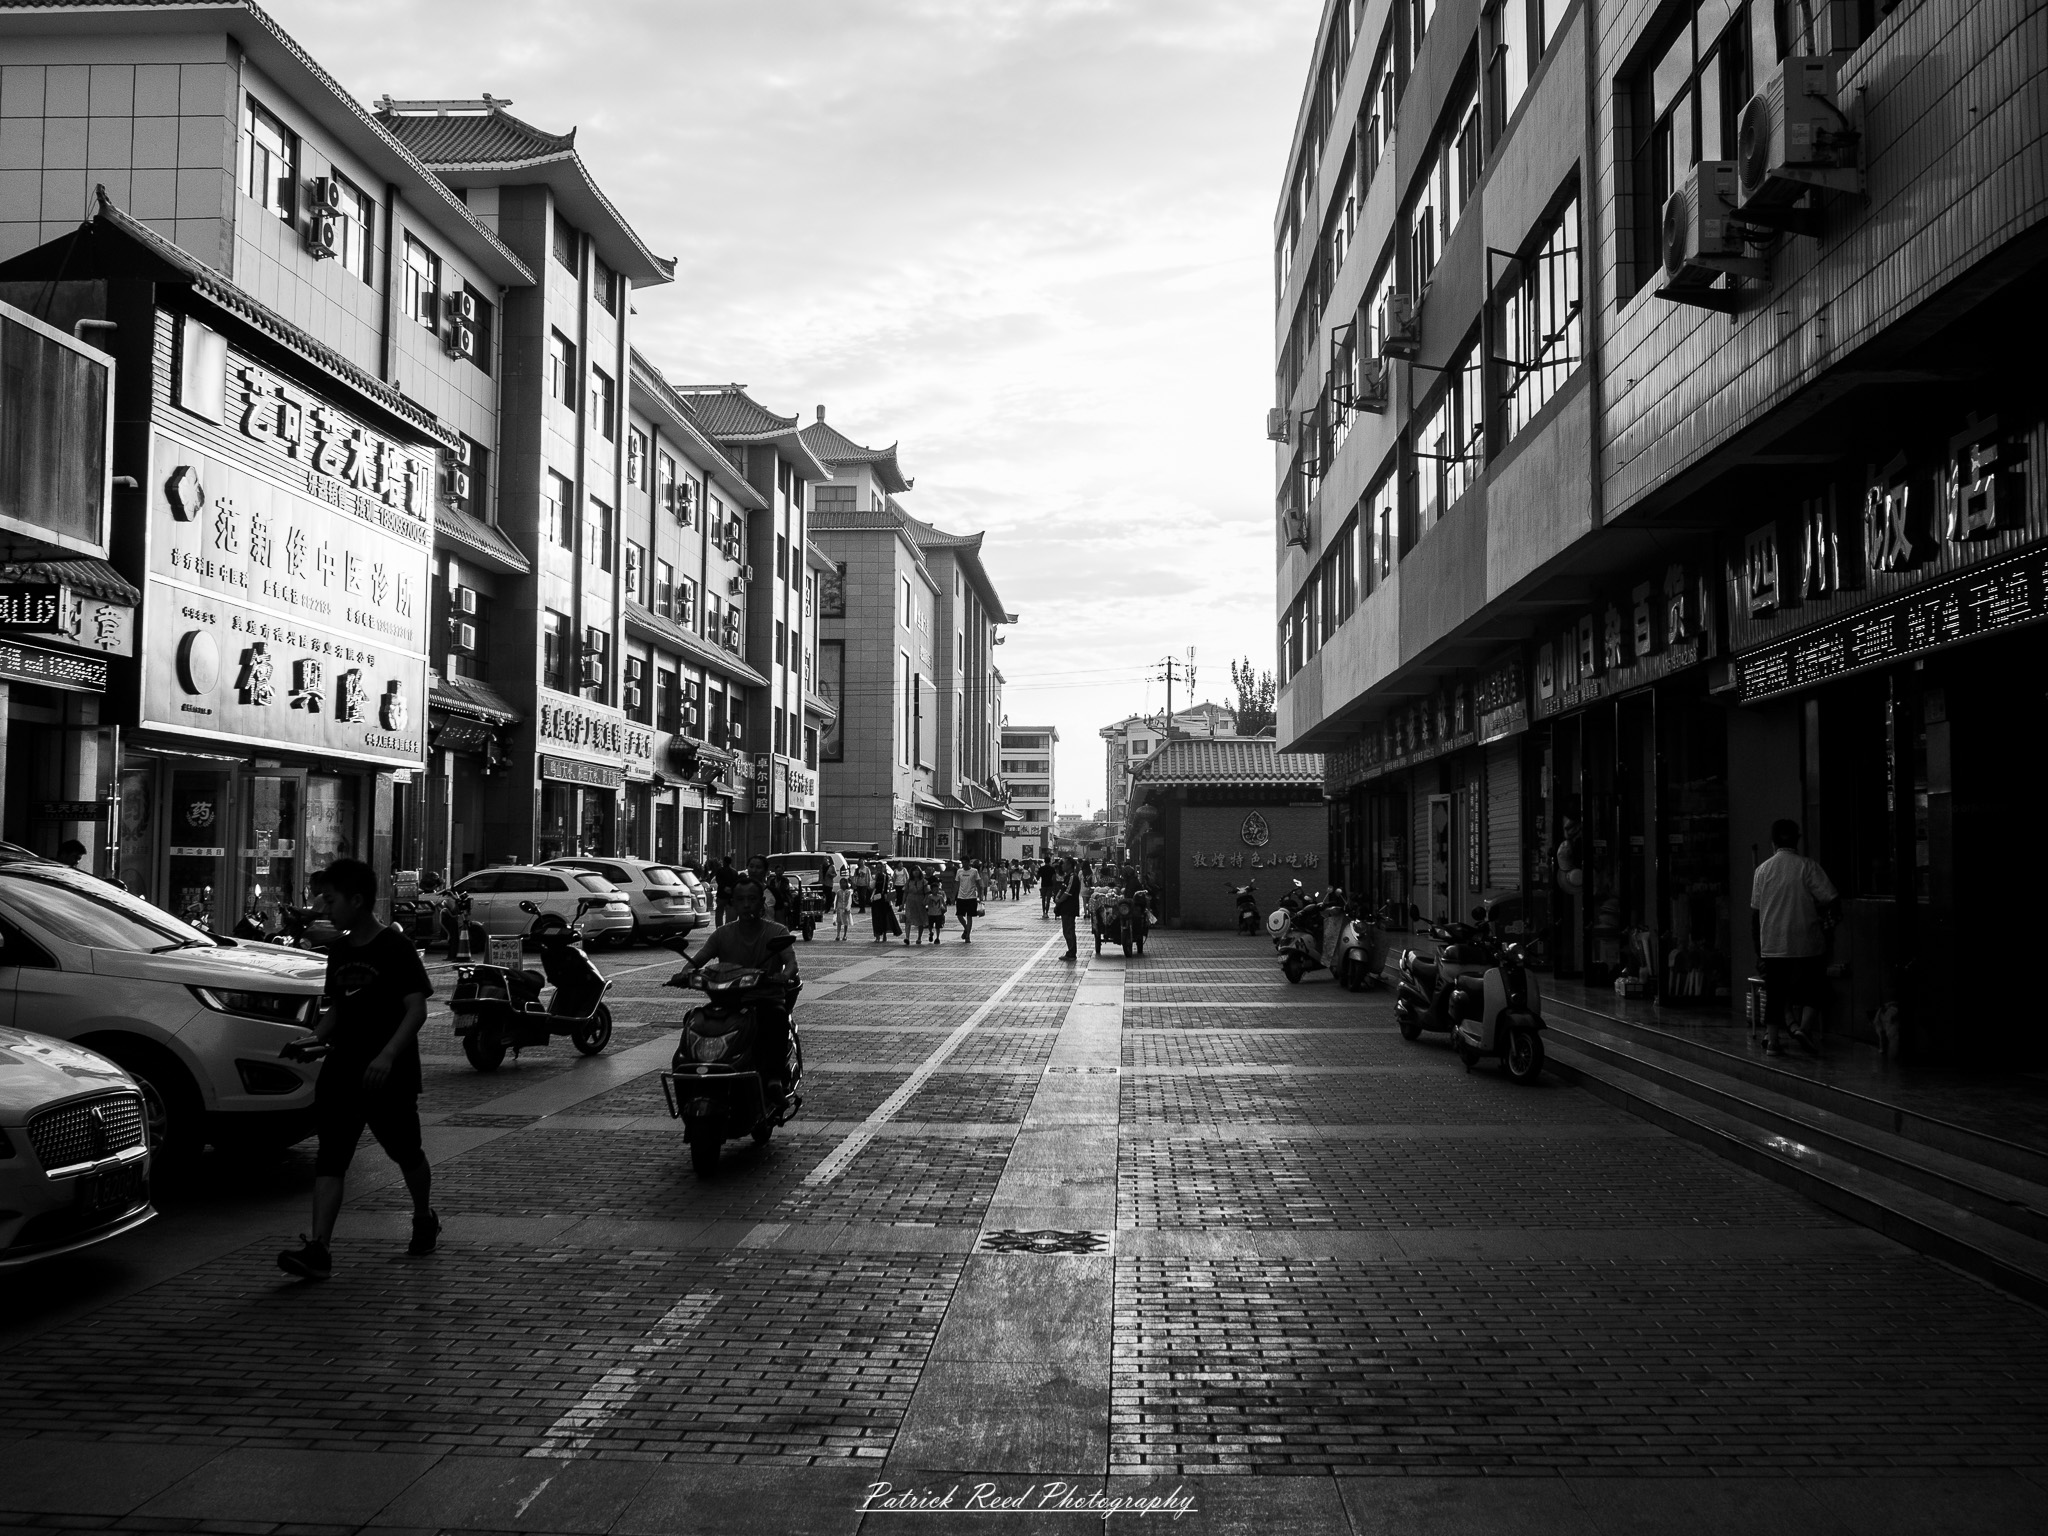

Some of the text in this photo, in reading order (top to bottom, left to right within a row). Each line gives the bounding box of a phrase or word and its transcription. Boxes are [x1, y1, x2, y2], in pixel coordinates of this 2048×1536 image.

[239, 366, 428, 521] 艺可艺术培训
[1744, 410, 1998, 619] 四川饭店
[756, 757, 769, 809] 卓尔口腔
[190, 801, 212, 820] 药
[1192, 851, 1320, 869] 敦煌特色小吃街
[493, 951, 518, 960] 禁止停放
